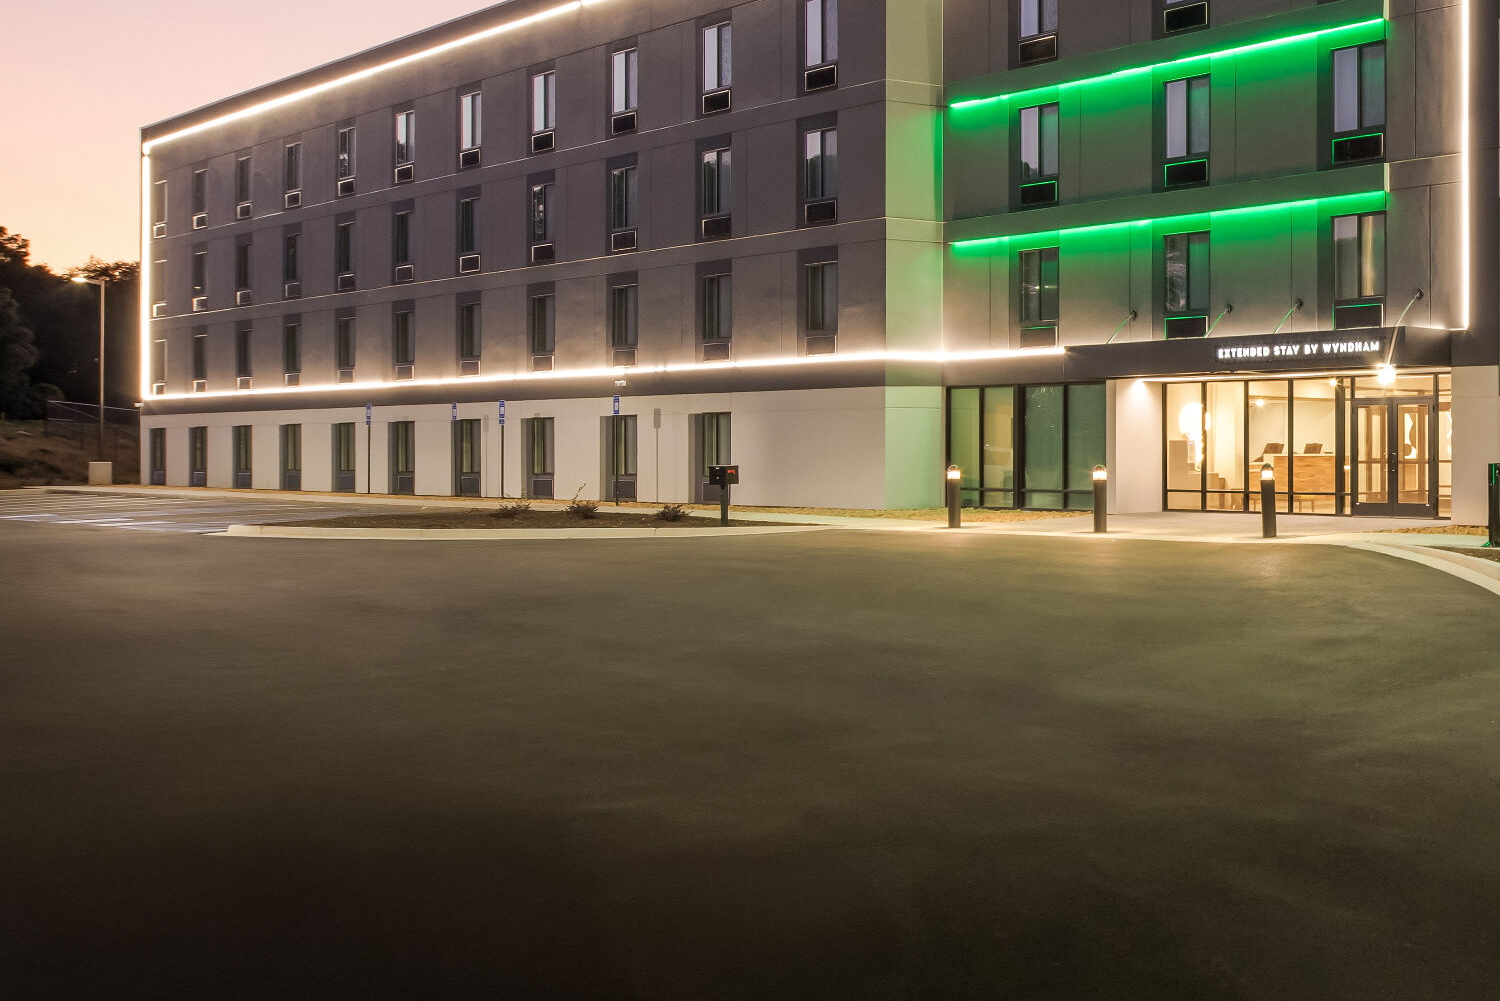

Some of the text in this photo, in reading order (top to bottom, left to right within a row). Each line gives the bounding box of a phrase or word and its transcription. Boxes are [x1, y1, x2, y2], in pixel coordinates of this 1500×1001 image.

[1217, 341, 1380, 359] EXTENDED STAY BY WYNDHAM
